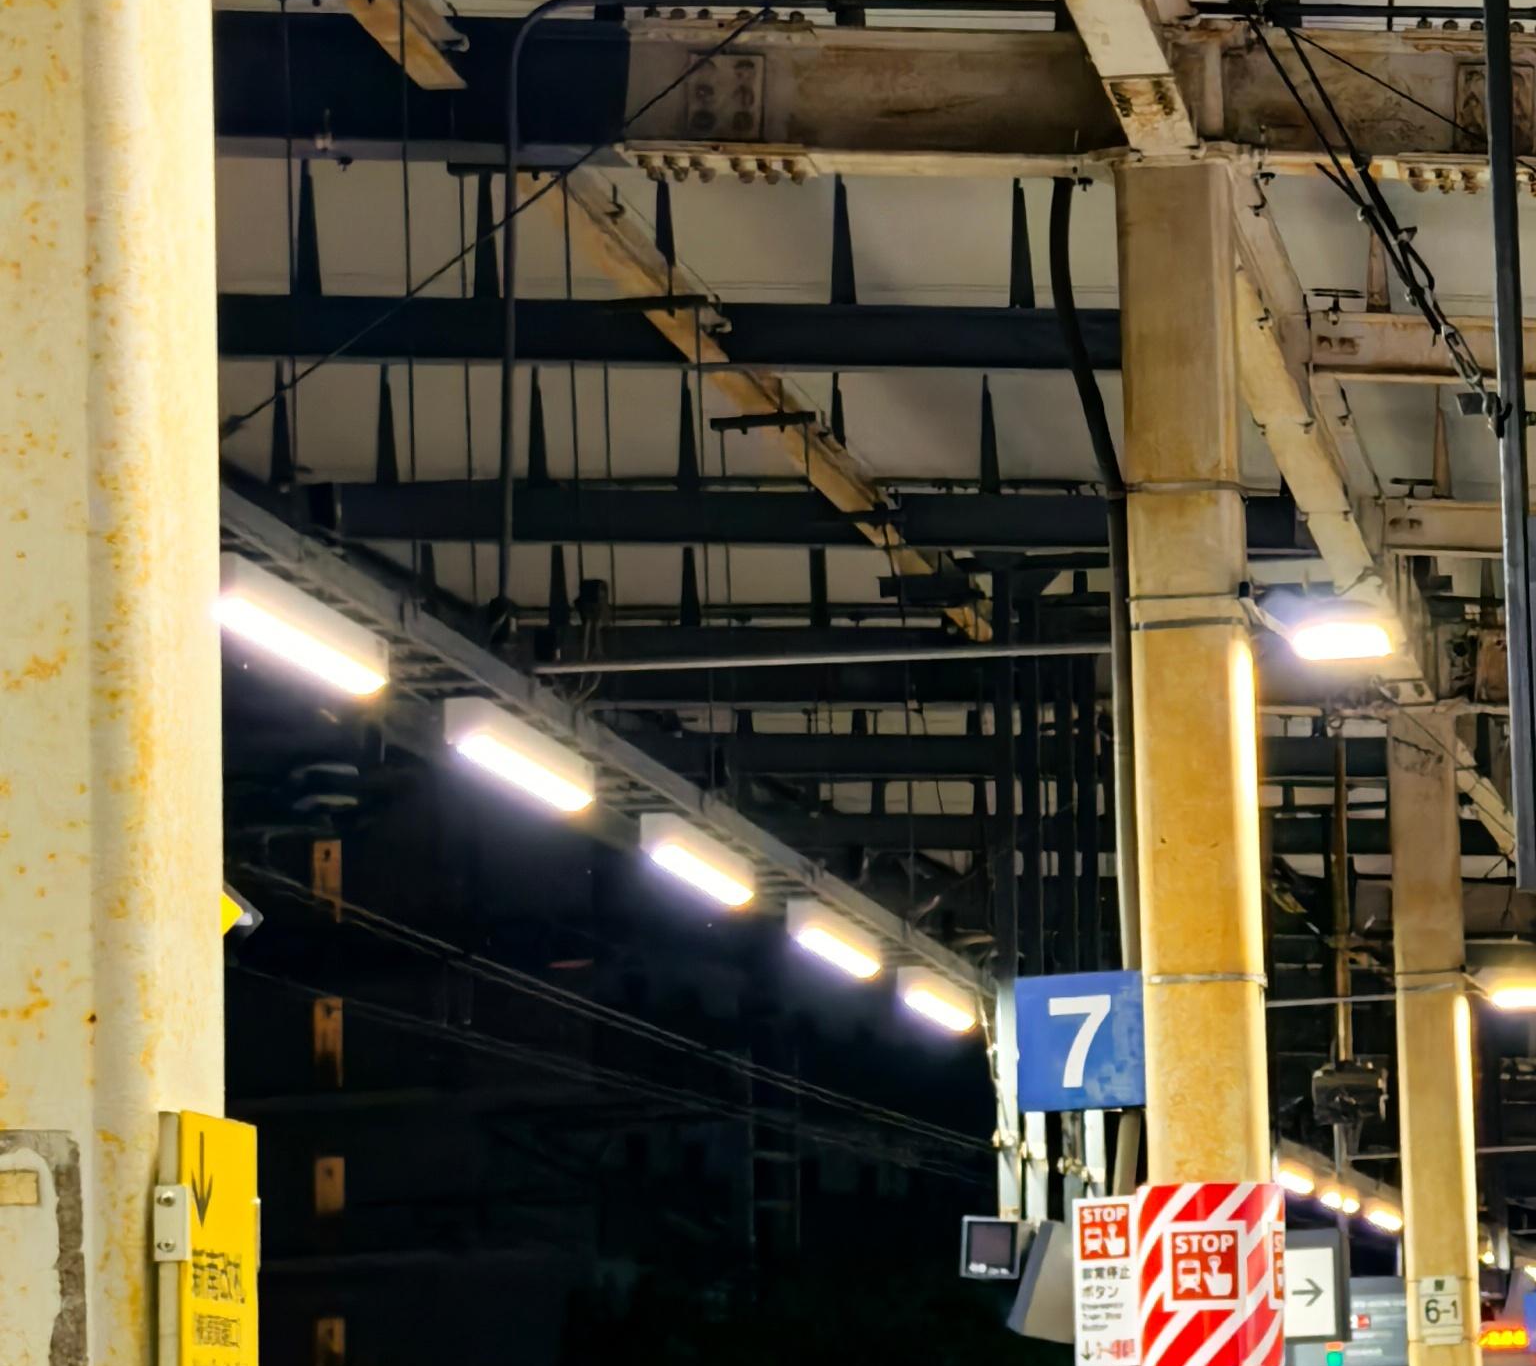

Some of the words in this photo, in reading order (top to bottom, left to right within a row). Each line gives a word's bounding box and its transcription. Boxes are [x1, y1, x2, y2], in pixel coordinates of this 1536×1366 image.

[1049, 994, 1111, 1088] 7
[1081, 1206, 1127, 1224] STOP
[1175, 1234, 1234, 1254] STOP
